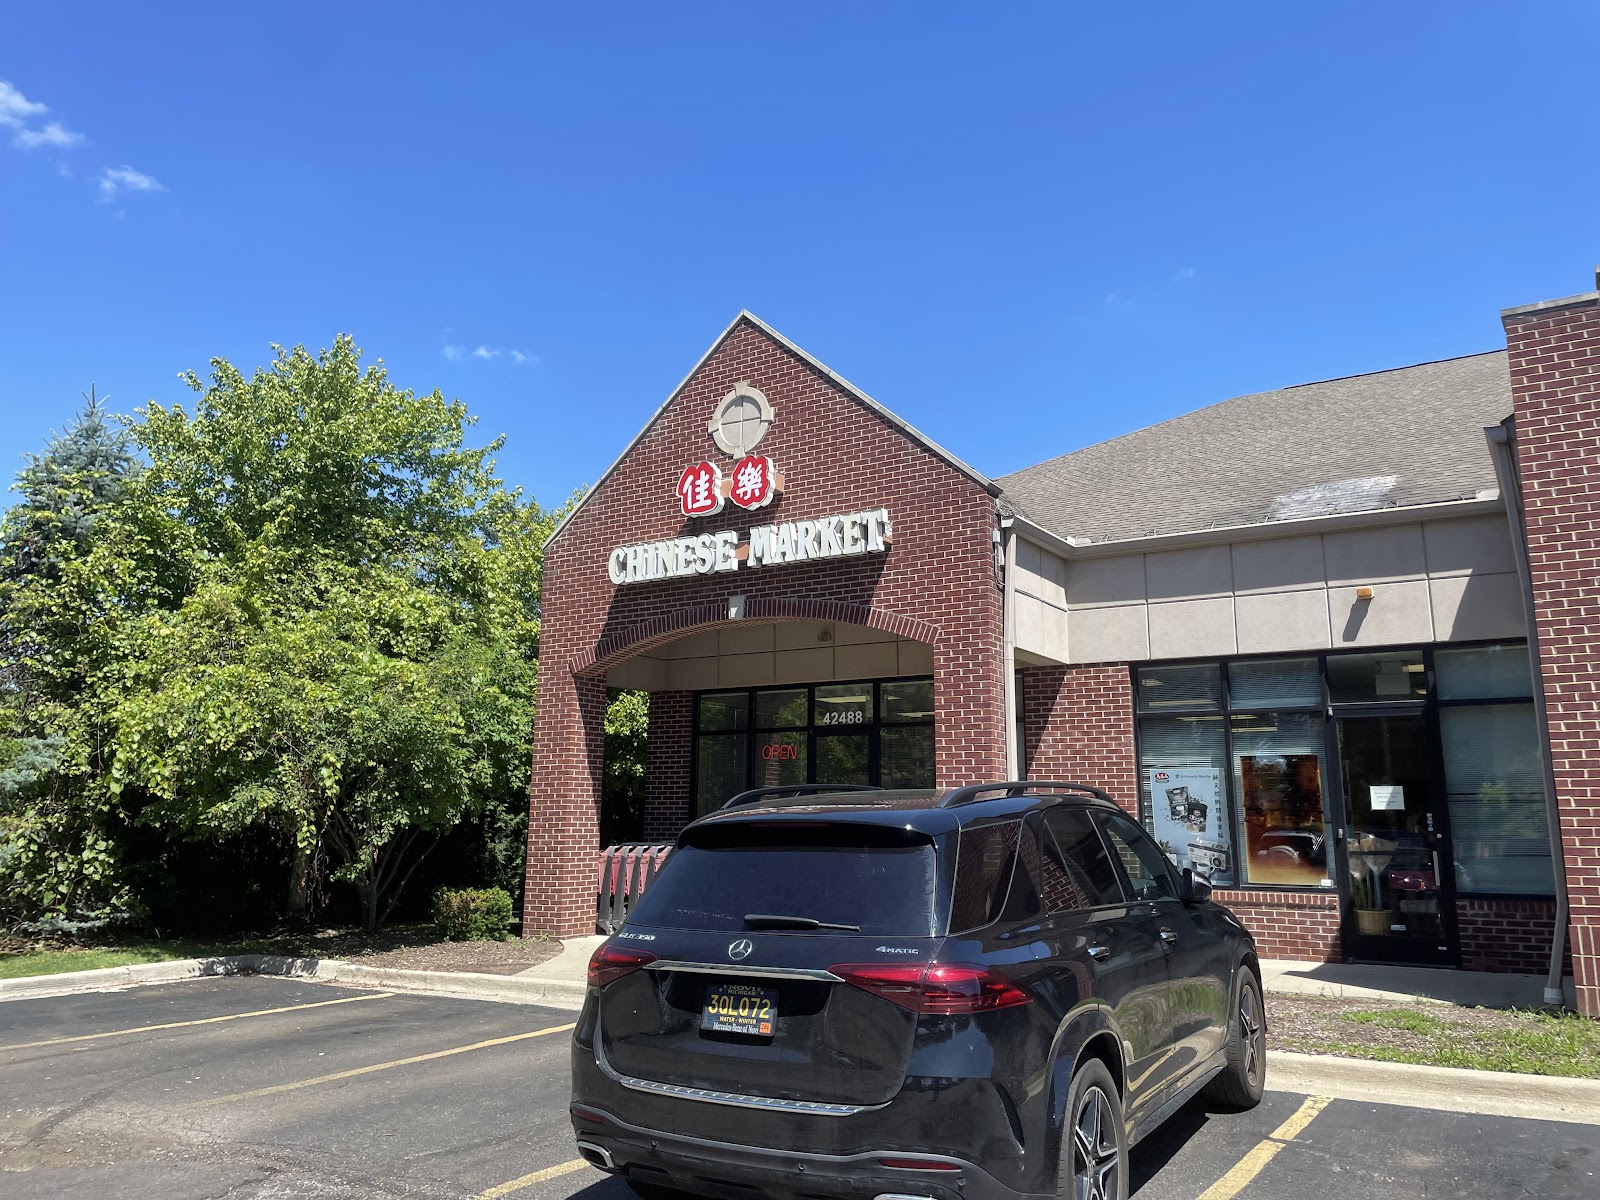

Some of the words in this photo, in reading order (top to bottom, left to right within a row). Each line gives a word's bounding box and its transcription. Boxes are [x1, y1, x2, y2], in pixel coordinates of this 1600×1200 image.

[682, 461, 765, 511] 佳樂
[608, 530, 738, 585] CHINESE
[747, 508, 890, 567] MARKET
[822, 710, 863, 725] 42488
[761, 744, 798, 760] OPEN
[876, 946, 919, 954] 4MATIC
